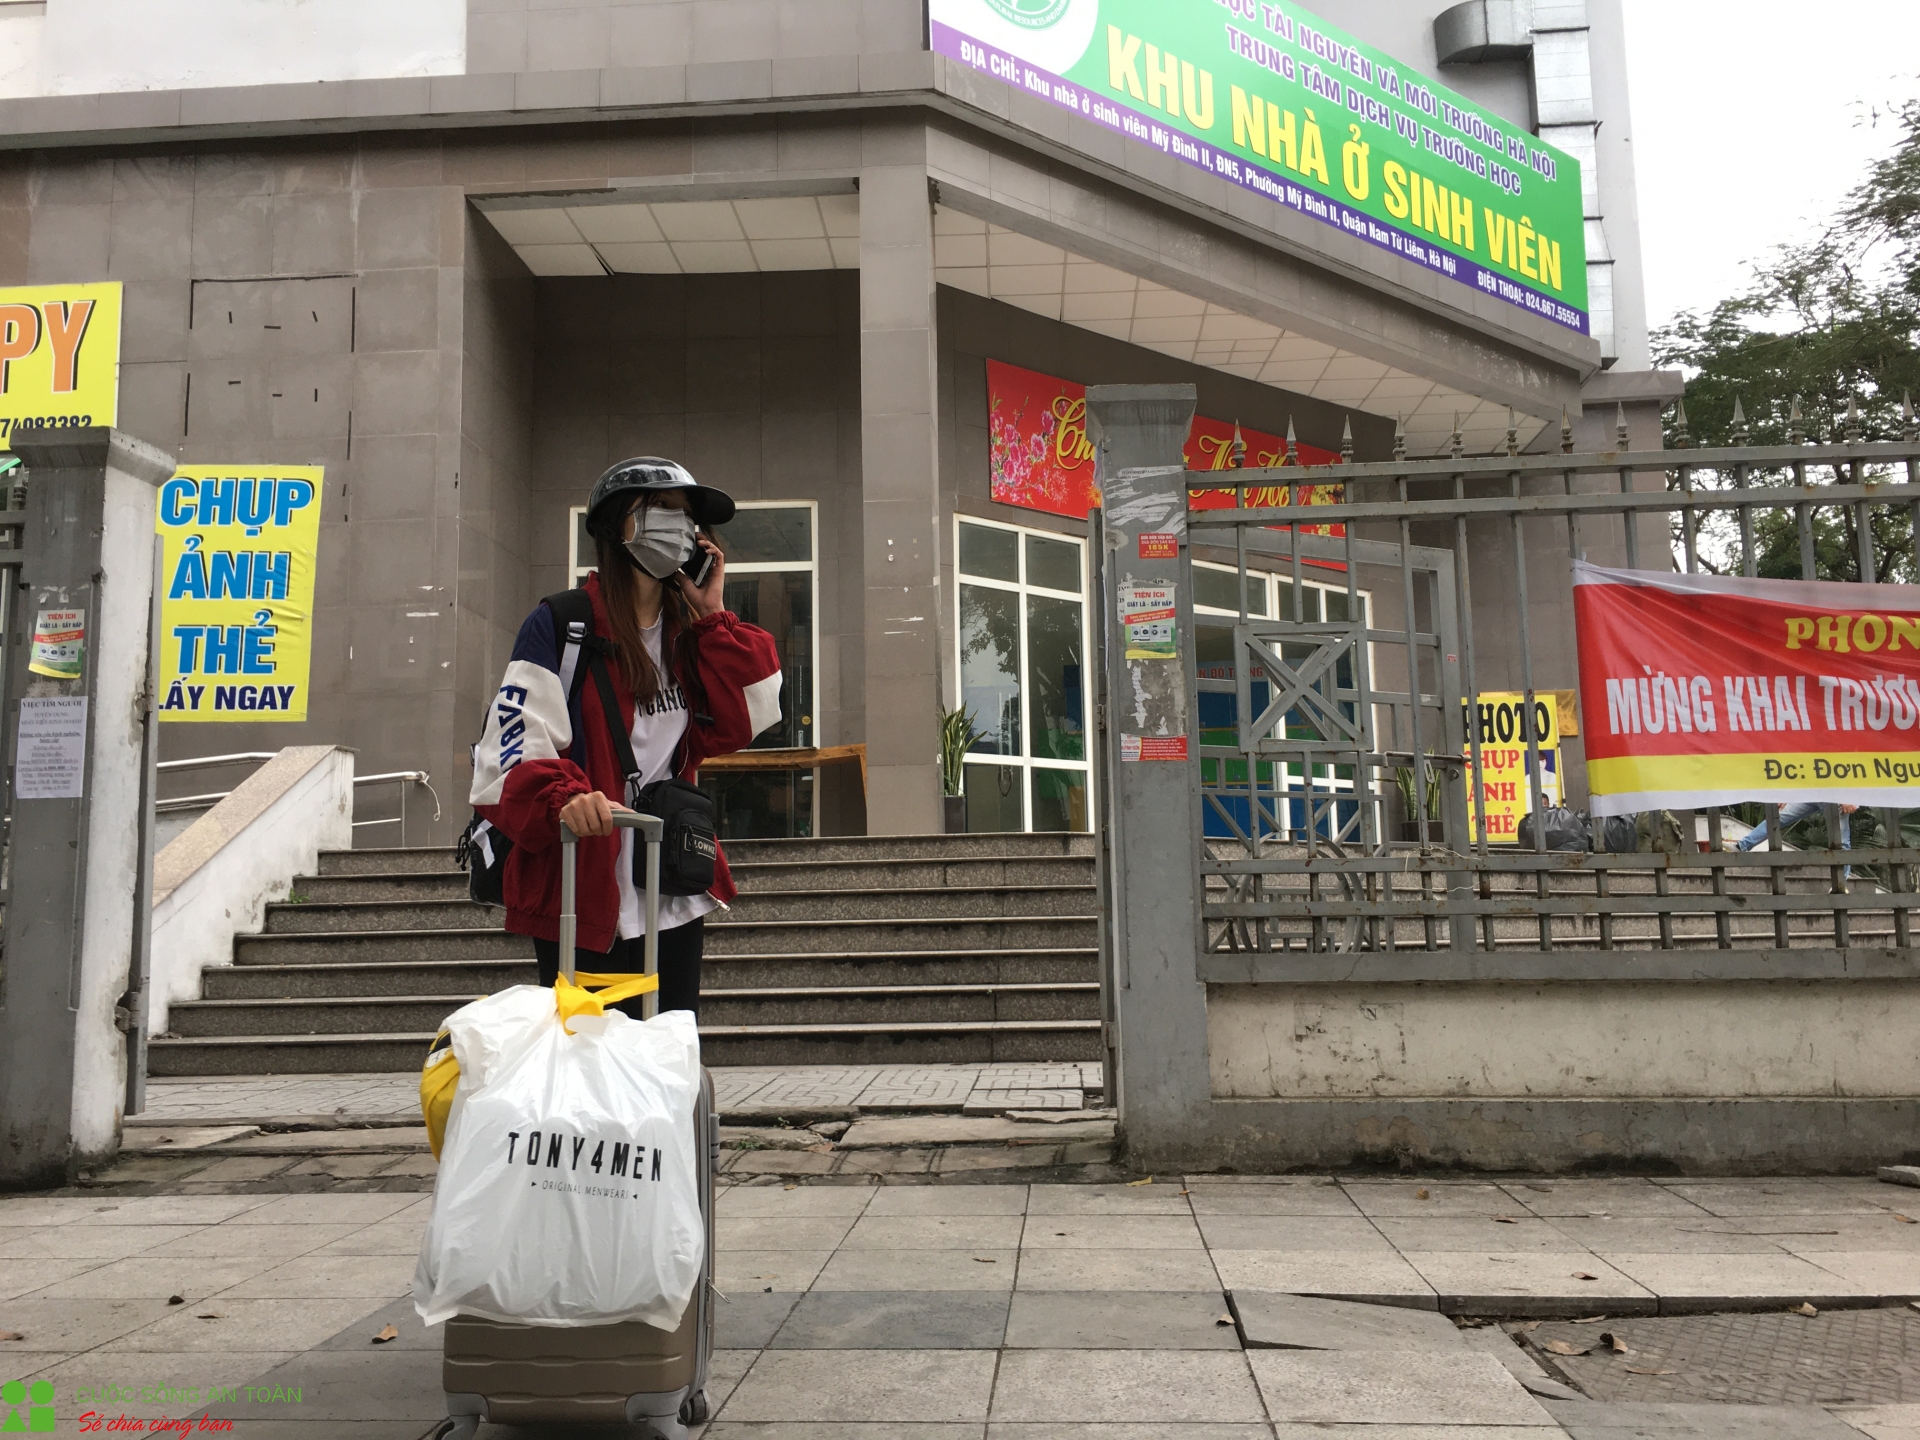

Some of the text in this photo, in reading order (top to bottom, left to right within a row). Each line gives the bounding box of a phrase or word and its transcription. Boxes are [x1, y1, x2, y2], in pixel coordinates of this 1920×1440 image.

[1214, 0, 1556, 182] ỌC TÀI NGUYÊN VÀ MÔI TRƯỜNG HÀ NỘI
[1227, 25, 1521, 196] TRUNG TÂM DỊCH VỤ TRƯỜNG HỌC
[960, 40, 1581, 329] ĐỊA CHỈ: Khu nhà ở sinh viên Mỹ Đình II, ĐN5, Phường Mỹ Đình II, Quận Nam Từ Liêm, Hà Nội ĐIỆN THOẠI: 024.667.55554
[1107, 23, 1562, 292] KHU NHÀ Ở SINH VIÊN
[161, 477, 315, 538] CHỤP
[168, 535, 292, 601] ẢNH
[1133, 591, 1151, 599] TIỆN
[173, 609, 277, 676] THẺ
[158, 676, 296, 712] ẤY NGAY
[1605, 665, 1718, 736] MỪNG
[1723, 675, 1812, 732] KHAI
[1764, 759, 1807, 781] Đc:
[1812, 757, 1867, 780] Đơn
[1471, 806, 1517, 834] HẺ
[508, 1131, 662, 1183] TONY4MEN
[541, 1180, 630, 1201] ORIGINAL MENWEARS
